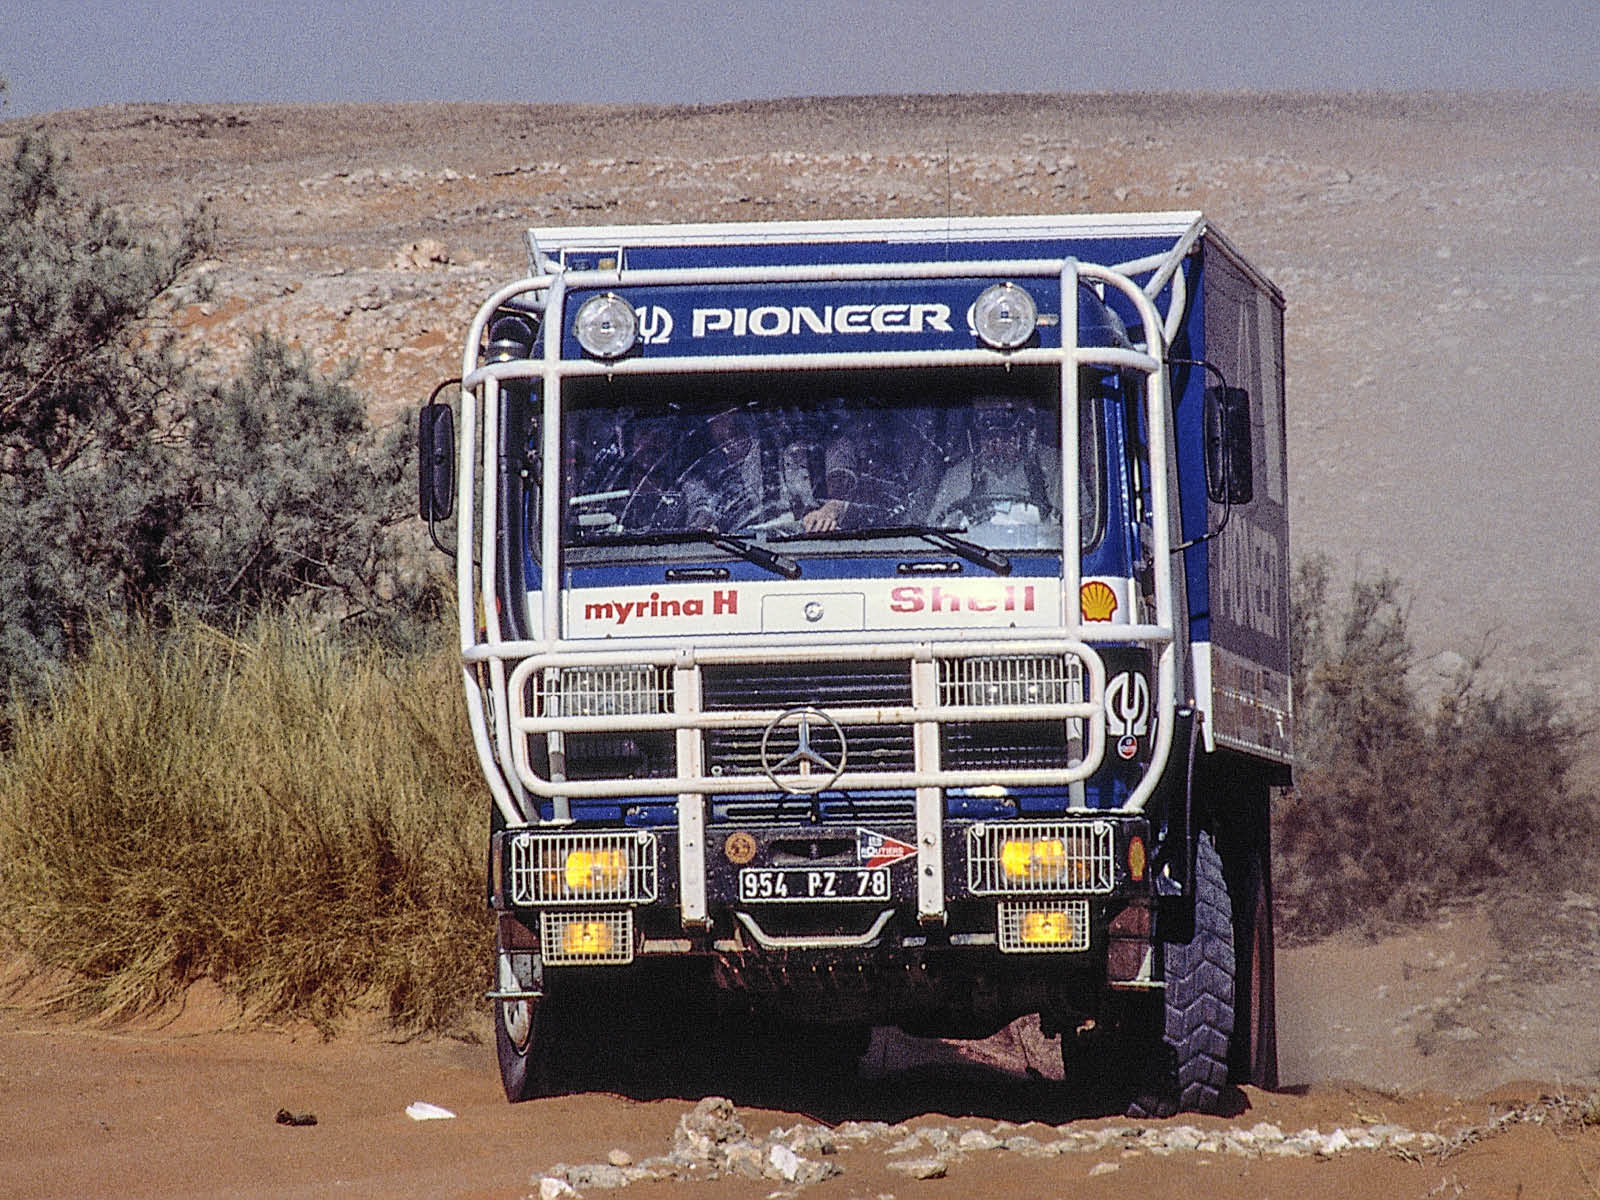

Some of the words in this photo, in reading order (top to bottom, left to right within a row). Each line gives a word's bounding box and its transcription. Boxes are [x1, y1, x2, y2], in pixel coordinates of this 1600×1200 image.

[692, 304, 953, 338] PIONEER
[585, 592, 703, 624] myrina
[714, 590, 738, 614] H
[744, 872, 788, 897] 954
[808, 872, 836, 897] PZ
[857, 872, 886, 896] 78
